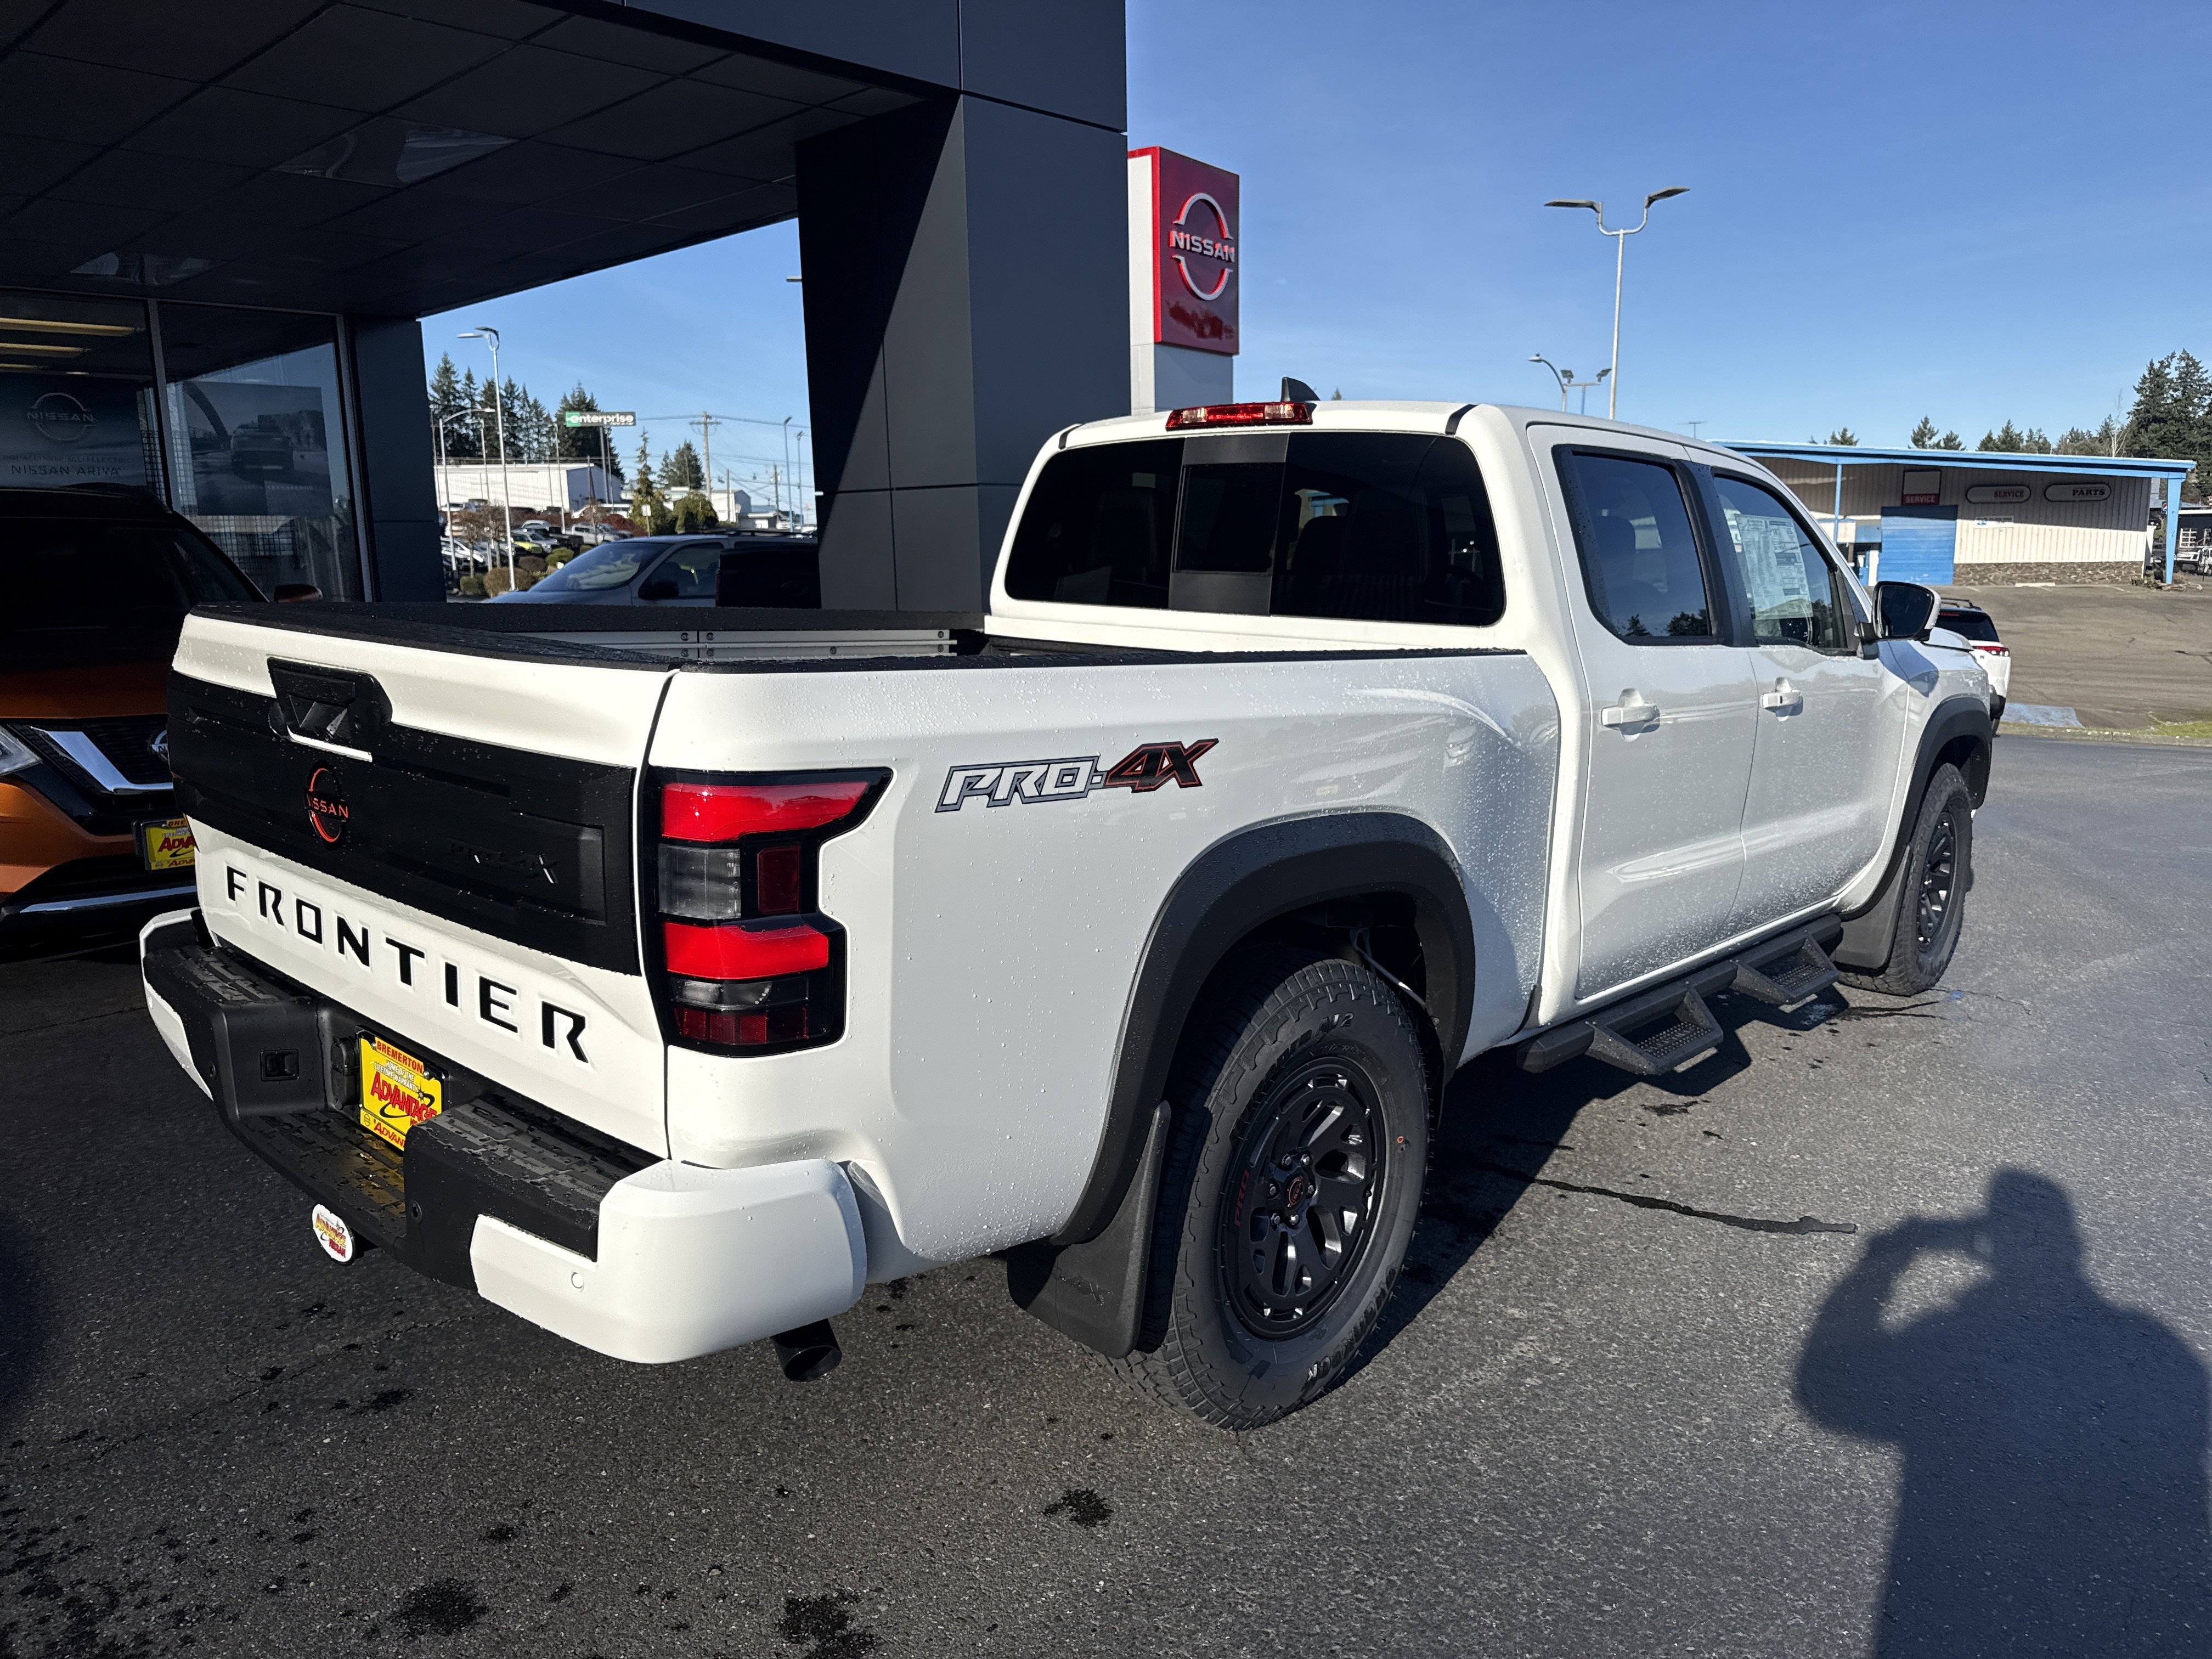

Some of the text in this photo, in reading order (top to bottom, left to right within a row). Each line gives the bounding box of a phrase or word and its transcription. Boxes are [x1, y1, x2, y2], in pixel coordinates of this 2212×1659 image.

[1170, 230, 1235, 263] NISSAN
[27, 411, 95, 422] NISSAN
[570, 413, 634, 425] enterprise
[11, 465, 119, 476] NISSAN ARIYA
[1905, 495, 1936, 504] SERVICE
[2072, 488, 2106, 496] PARTS
[226, 865, 589, 1063] FRONTIER
[377, 1041, 424, 1074] BREMERTON
[375, 1062, 419, 1093] LIFETIME WARRANTY
[386, 1060, 415, 1082] HOME OF THE
[370, 1072, 437, 1123] ADVANTAGE
[315, 1214, 346, 1248] ADVANTAGE
